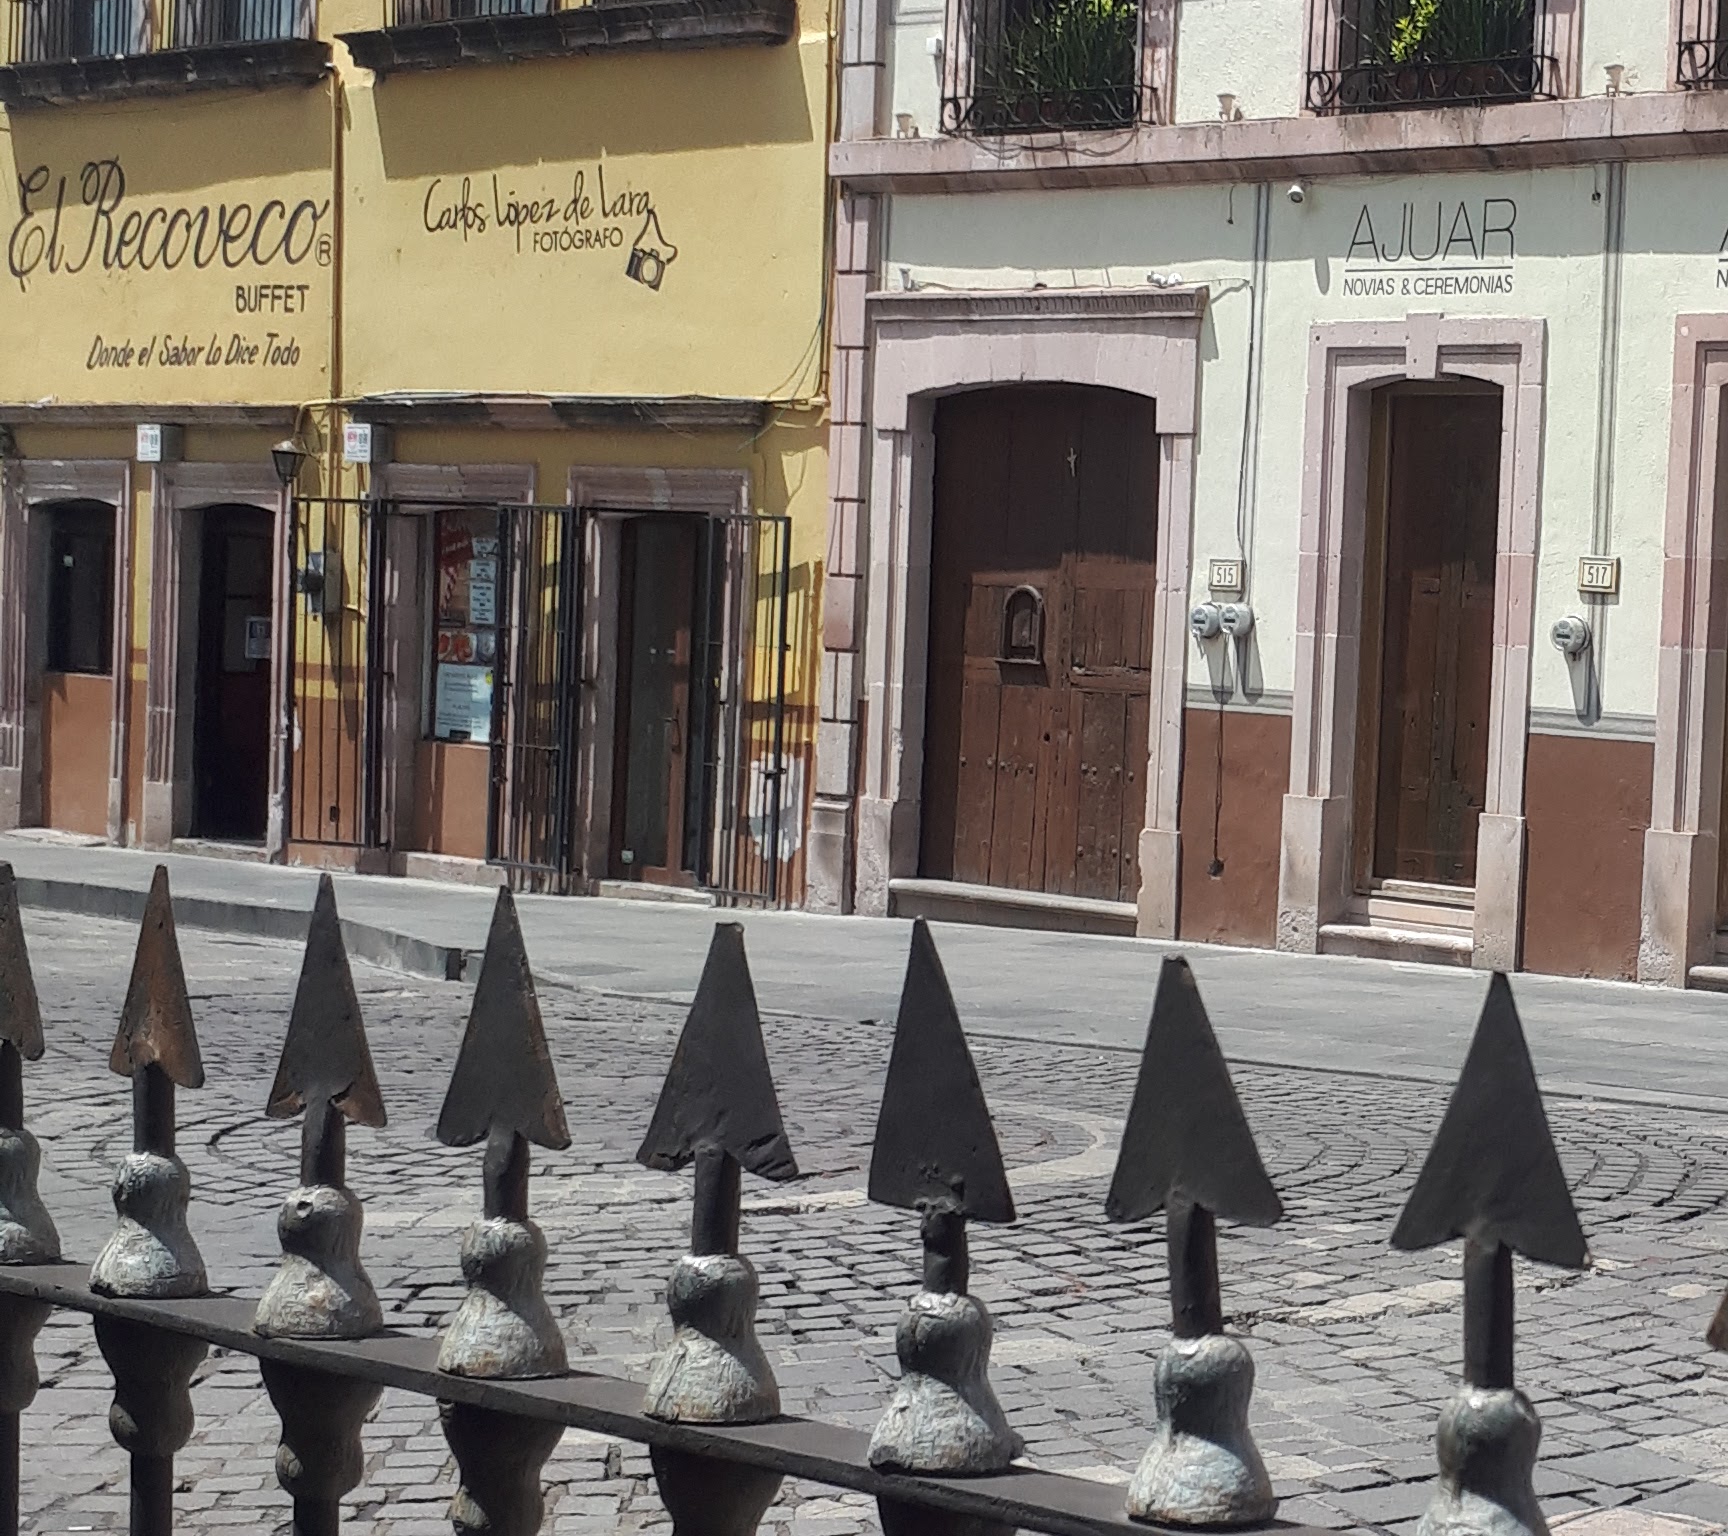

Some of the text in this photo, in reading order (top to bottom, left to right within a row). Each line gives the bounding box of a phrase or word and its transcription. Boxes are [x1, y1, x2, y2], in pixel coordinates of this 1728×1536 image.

[424, 178, 487, 243] Carlos
[563, 170, 594, 226] de
[598, 164, 652, 219] Lara
[8, 165, 65, 293] El
[66, 155, 331, 274] Recoveco
[1346, 198, 1517, 263] AJUAR
[533, 227, 623, 253] FOTÓGRAFO
[235, 284, 310, 313] BUFFET
[1343, 274, 1513, 297] NOVIAS & CEREMONIAS
[86, 332, 301, 371] Donde el Sabor Lo Dice Todo
[1216, 566, 1234, 584] 515
[1587, 565, 1608, 585] 517
